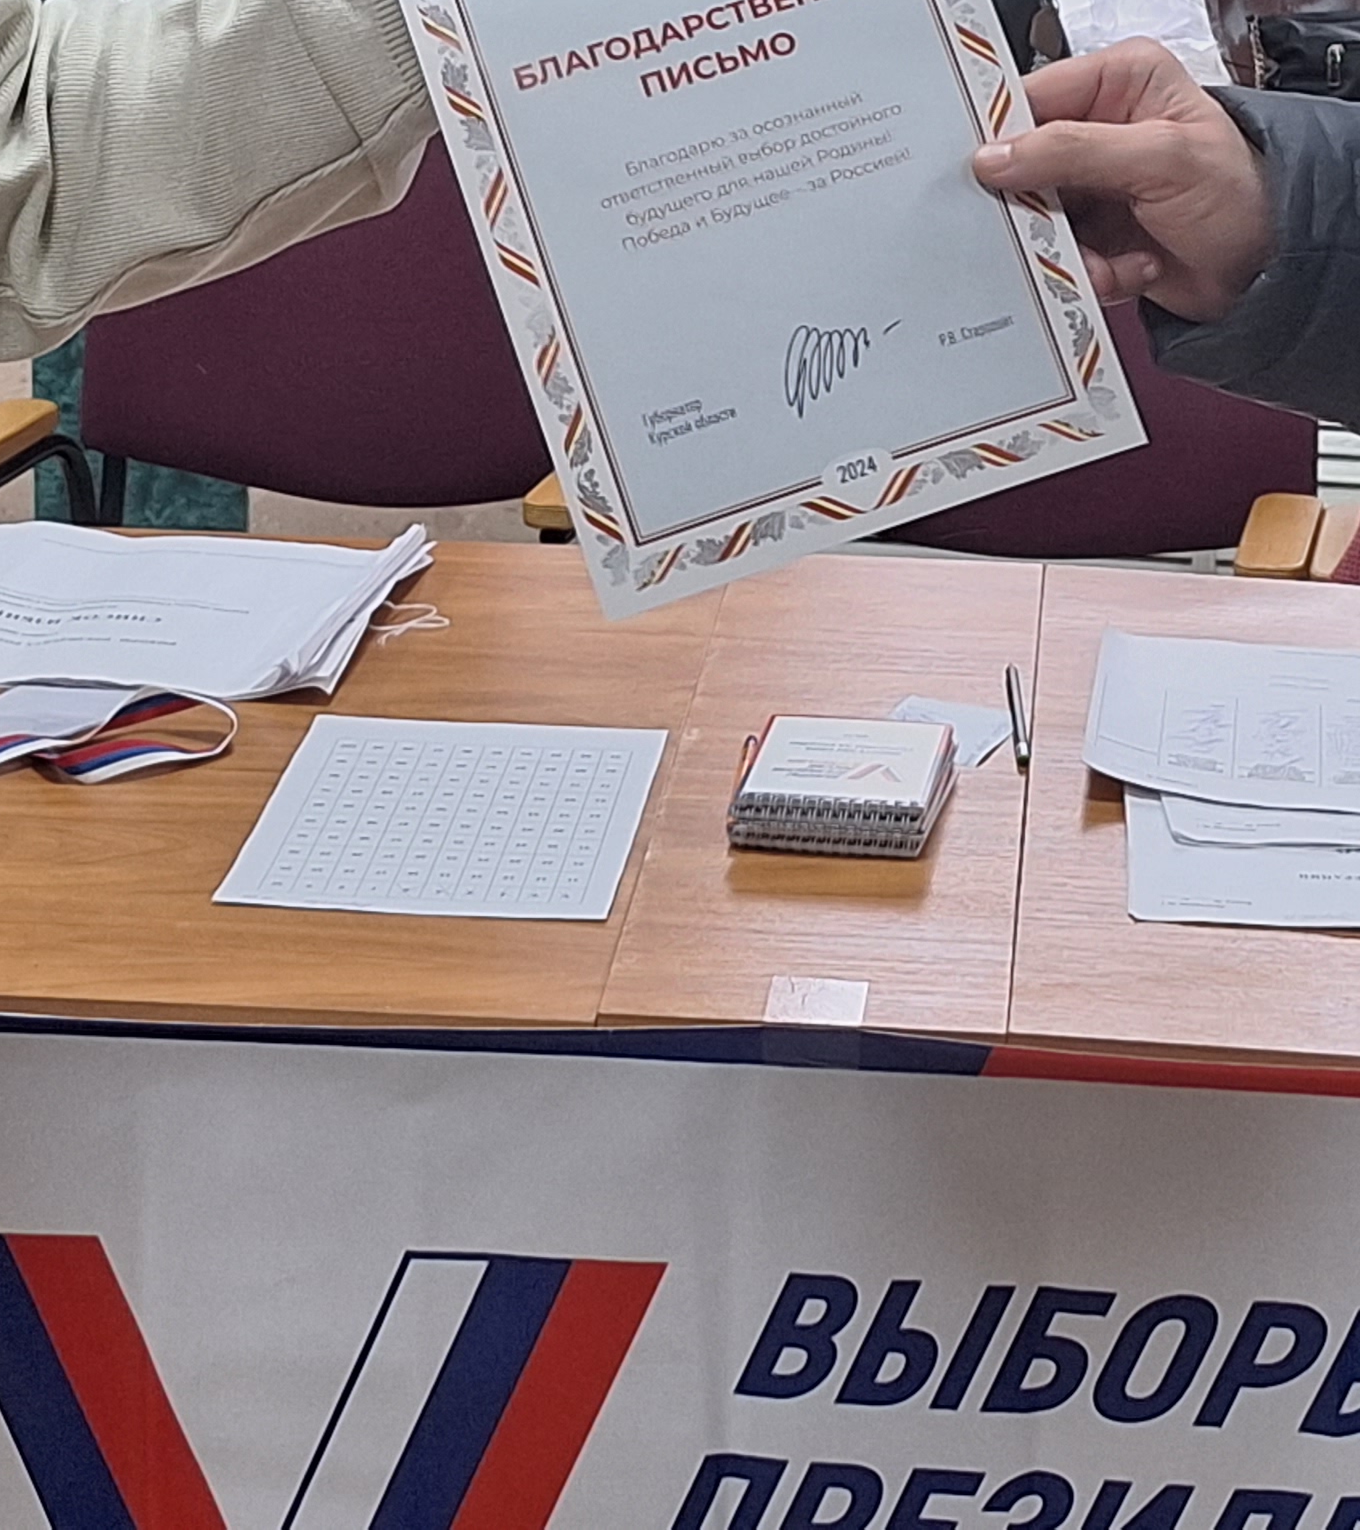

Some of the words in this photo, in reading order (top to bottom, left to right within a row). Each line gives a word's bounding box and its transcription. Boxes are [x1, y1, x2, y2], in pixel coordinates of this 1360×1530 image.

[639, 32, 797, 98] ПИСЬМО
[601, 155, 736, 210] ответственный
[738, 138, 796, 165] выбор
[800, 104, 902, 147] достойного
[625, 136, 726, 177] Благодарю
[729, 128, 749, 144] за
[752, 91, 864, 135] осознанный
[626, 189, 713, 227] будущего
[717, 177, 749, 198] для
[753, 155, 815, 184] нашей
[817, 128, 893, 163] Родины!
[622, 221, 692, 252] Победа
[696, 216, 709, 229] и
[710, 189, 791, 224] Будущее
[807, 177, 827, 192] за
[830, 146, 912, 183] Россией!
[836, 455, 878, 485] 2024
